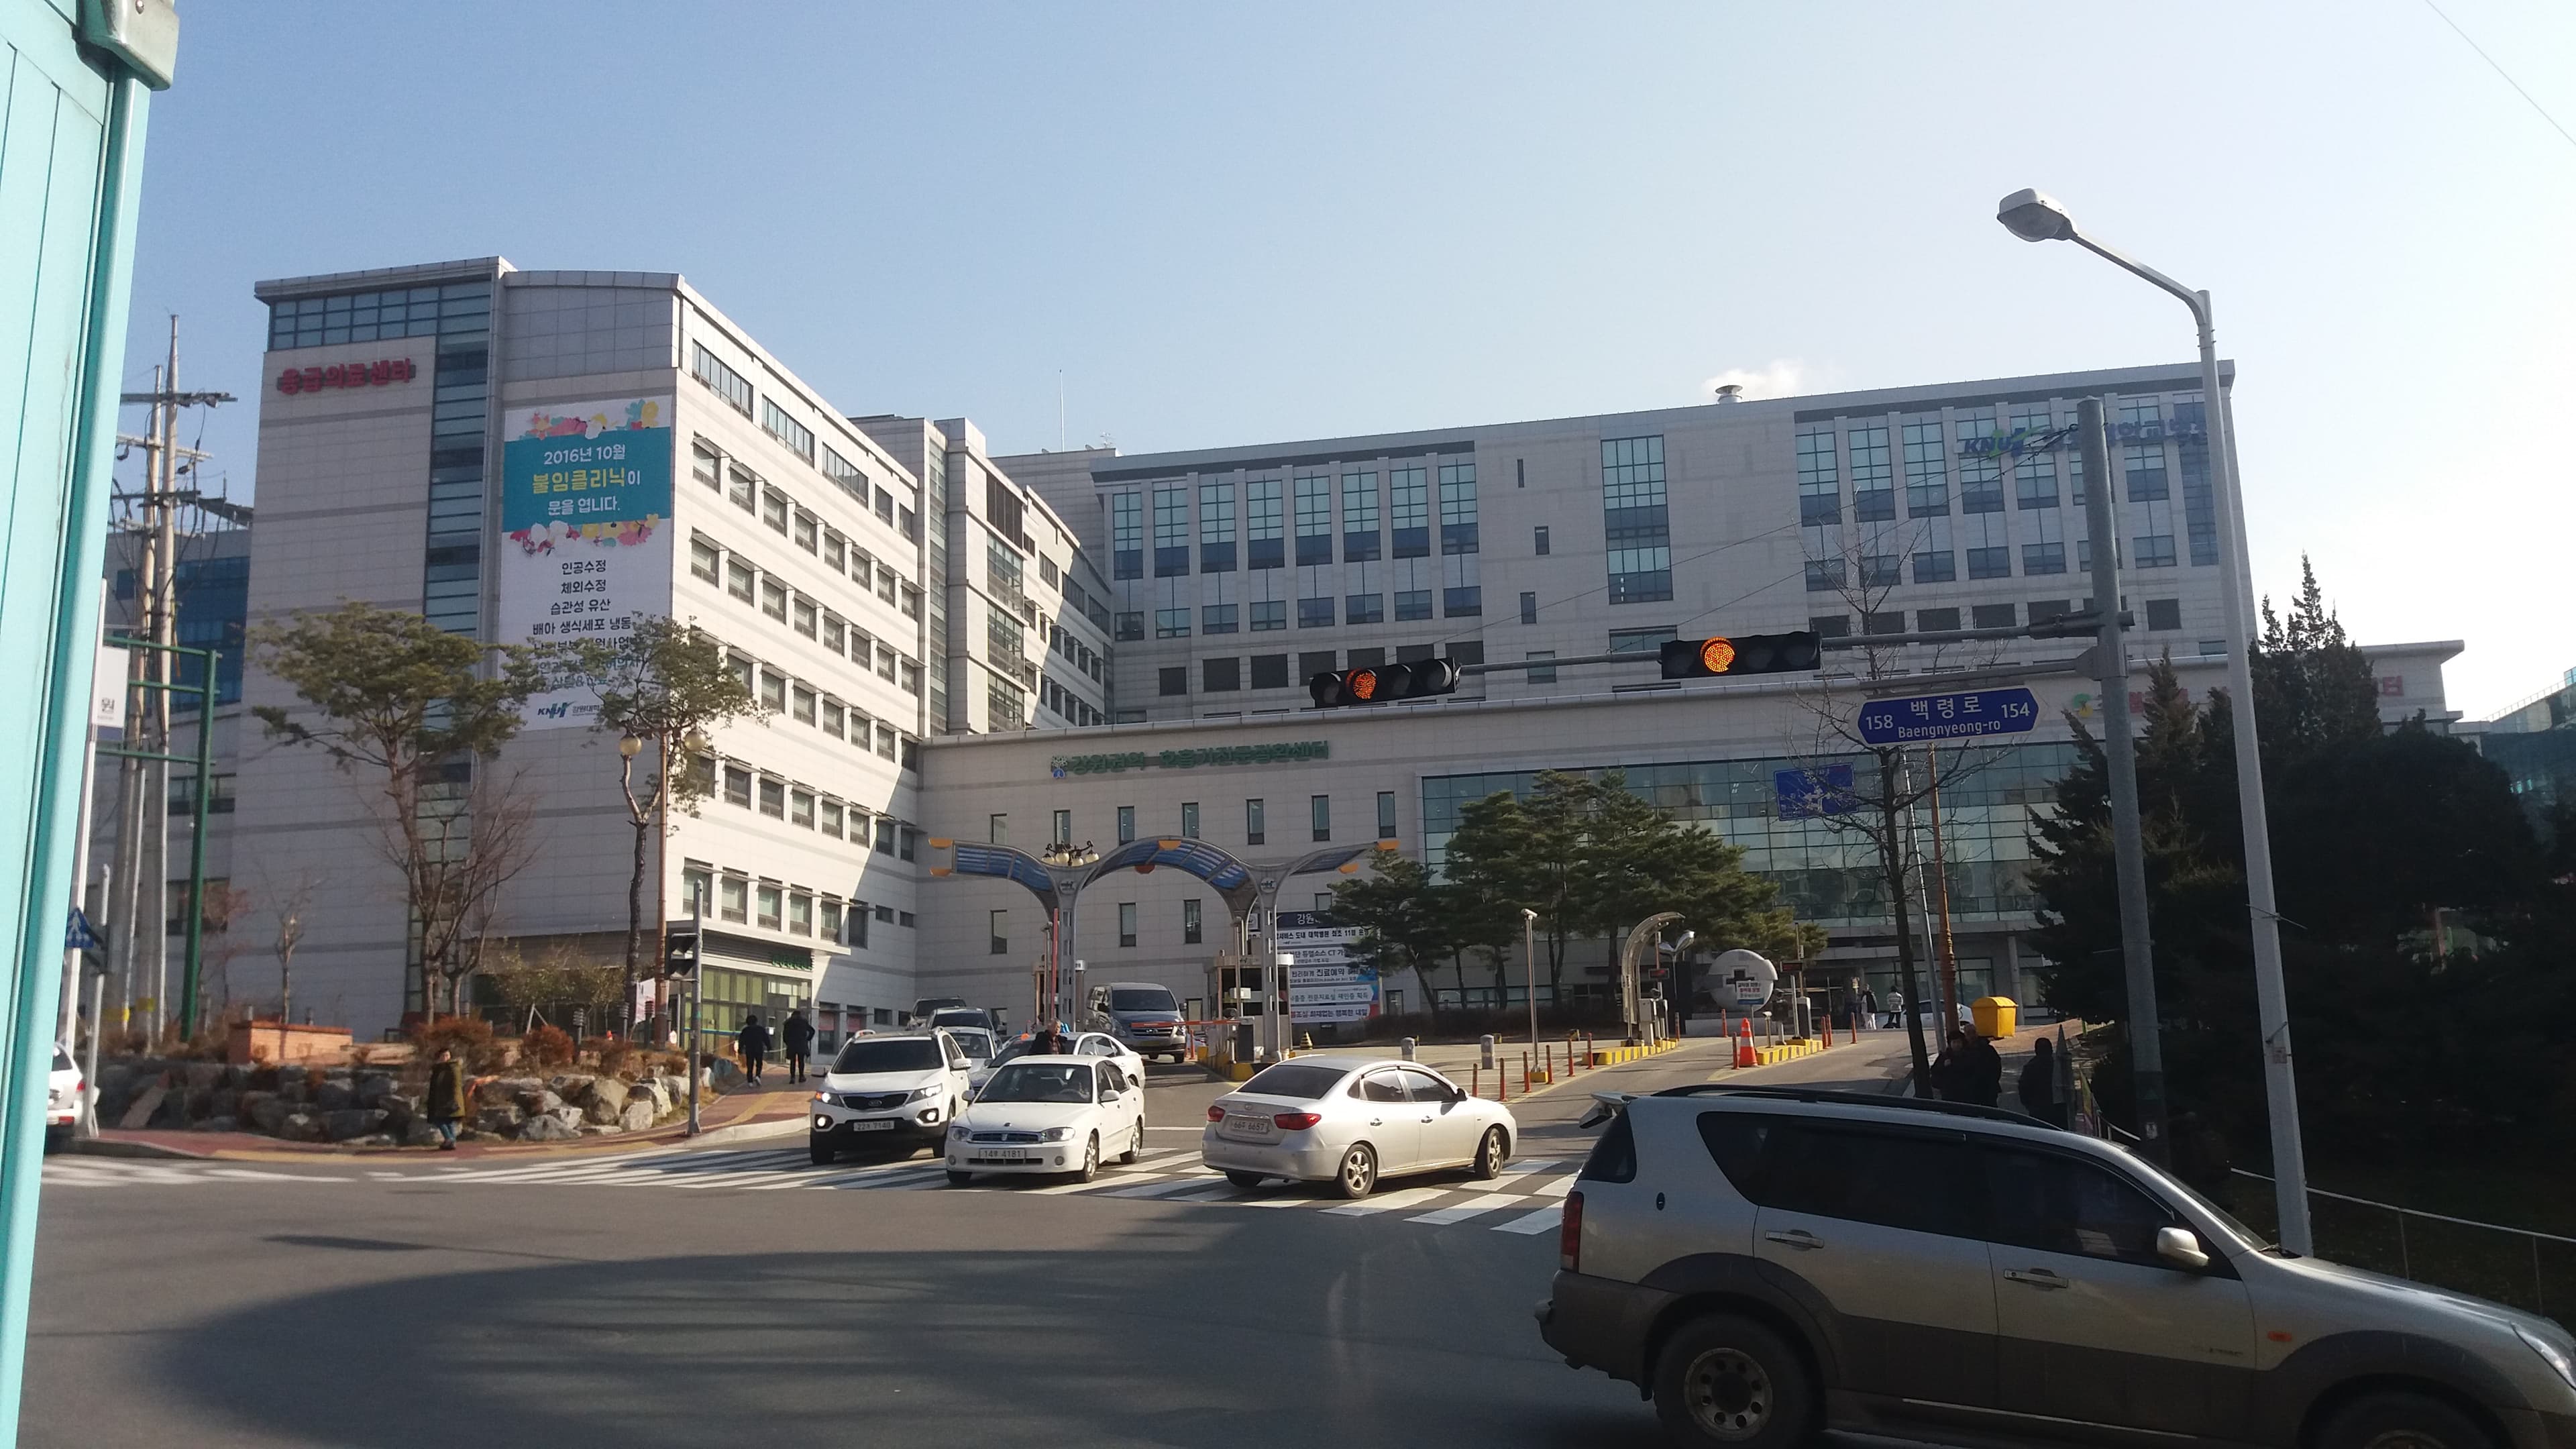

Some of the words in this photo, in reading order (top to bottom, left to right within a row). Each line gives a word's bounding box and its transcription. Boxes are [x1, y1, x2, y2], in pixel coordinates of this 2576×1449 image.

[281, 358, 411, 395] 응급의료센터
[543, 447, 592, 465] 2016년
[596, 443, 625, 460] 10월
[533, 468, 641, 494] 불임클리닉이
[548, 499, 574, 516] 문을
[578, 496, 621, 513] 엽니다.
[561, 559, 606, 575] 인공수정
[561, 580, 606, 594] 체외수정
[550, 601, 584, 616] 습관성
[588, 598, 610, 612] 유산
[533, 623, 555, 635] 배아
[560, 618, 605, 634] 생식세포
[610, 617, 631, 631] 냉동
[1866, 714, 1894, 731] 158
[1911, 696, 1982, 720] 백령로
[2001, 702, 2031, 718] 154
[1898, 720, 2001, 739] Baengnyeong-ro
